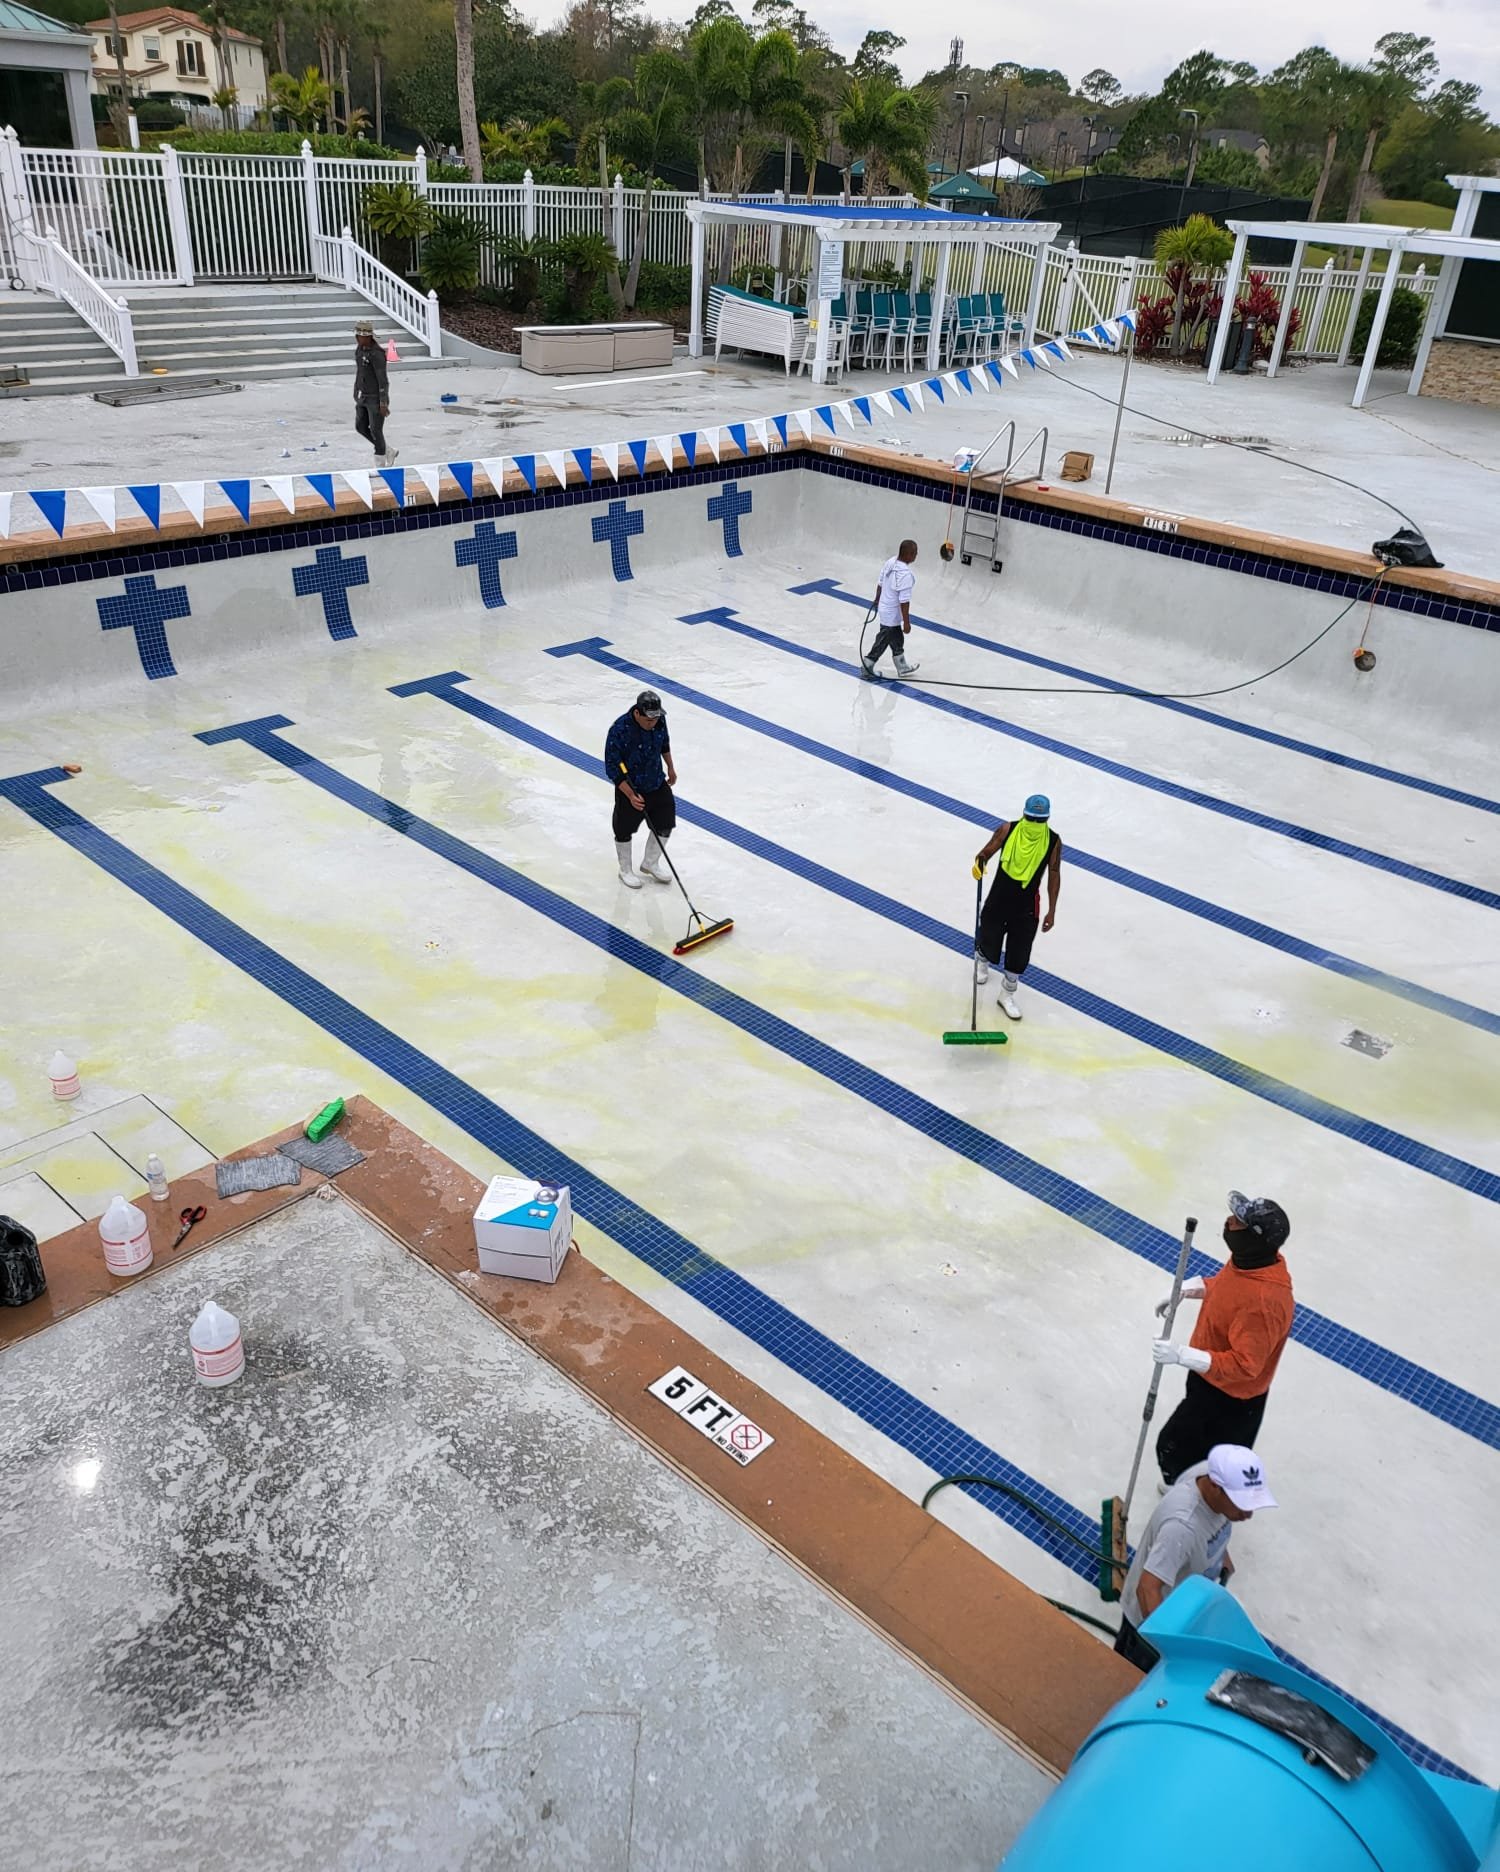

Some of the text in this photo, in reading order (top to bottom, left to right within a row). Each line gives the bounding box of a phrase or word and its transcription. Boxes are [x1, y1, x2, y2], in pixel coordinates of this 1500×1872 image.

[665, 1376, 734, 1432] 5 FT.
[716, 1436, 749, 1464] NO DIVING
